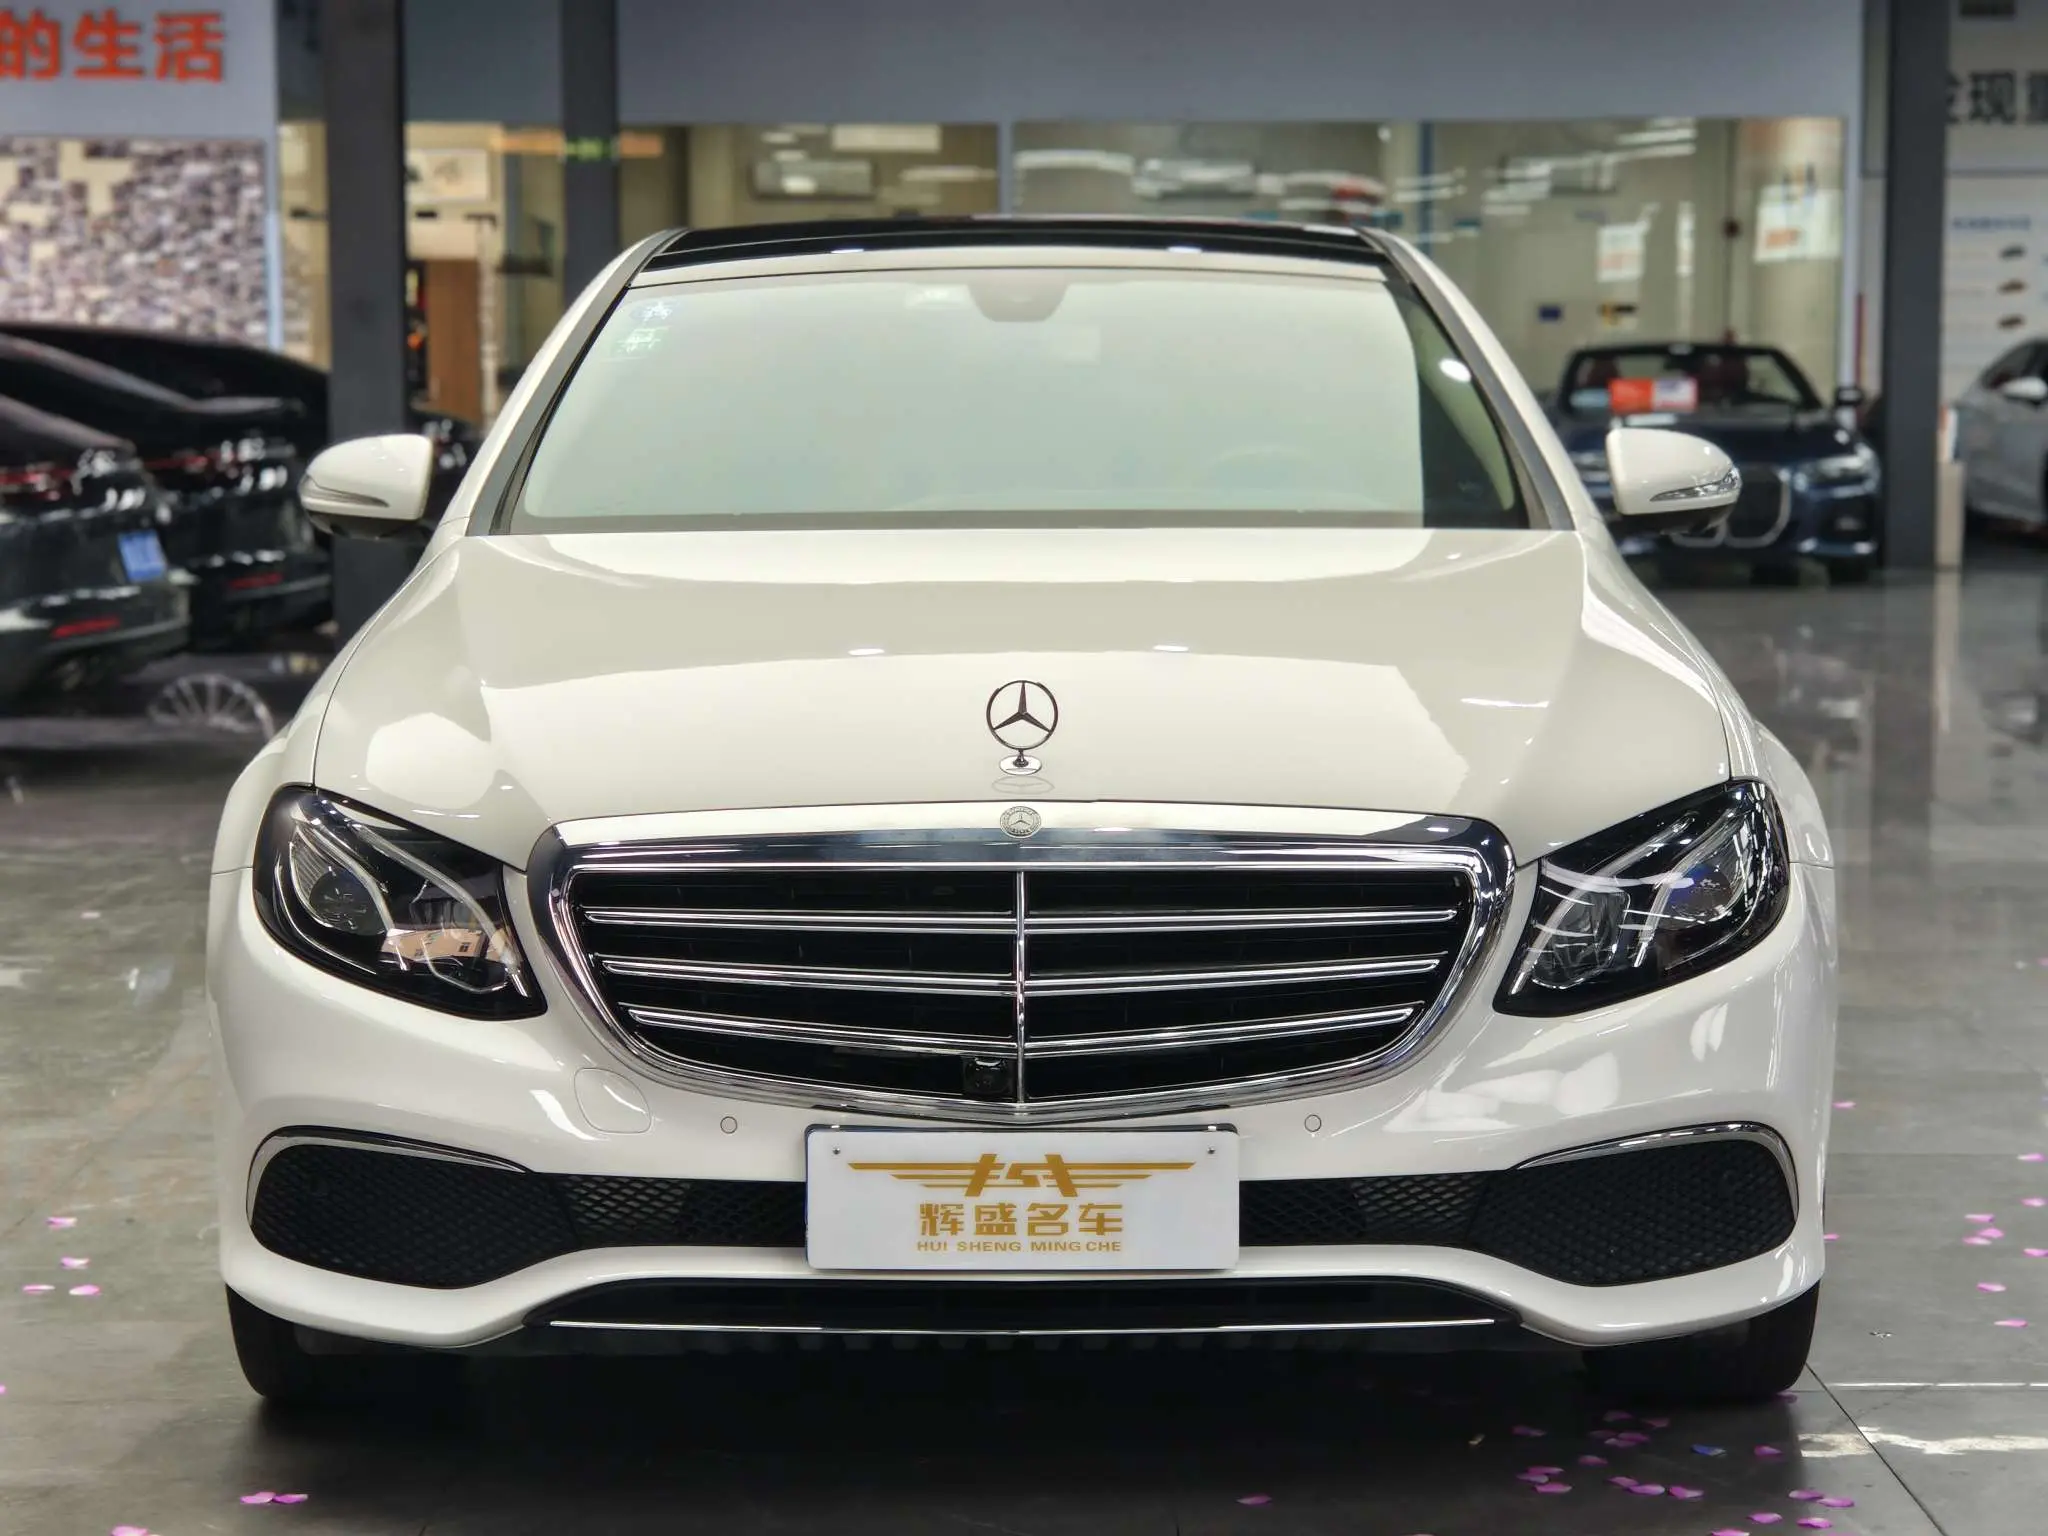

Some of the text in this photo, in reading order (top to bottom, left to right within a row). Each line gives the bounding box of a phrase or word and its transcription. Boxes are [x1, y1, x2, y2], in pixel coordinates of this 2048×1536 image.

[0, 9, 222, 82] 的生活
[919, 1202, 1122, 1236] 辉盛名车
[917, 1241, 1121, 1252] HUI SHENG MING CHE
